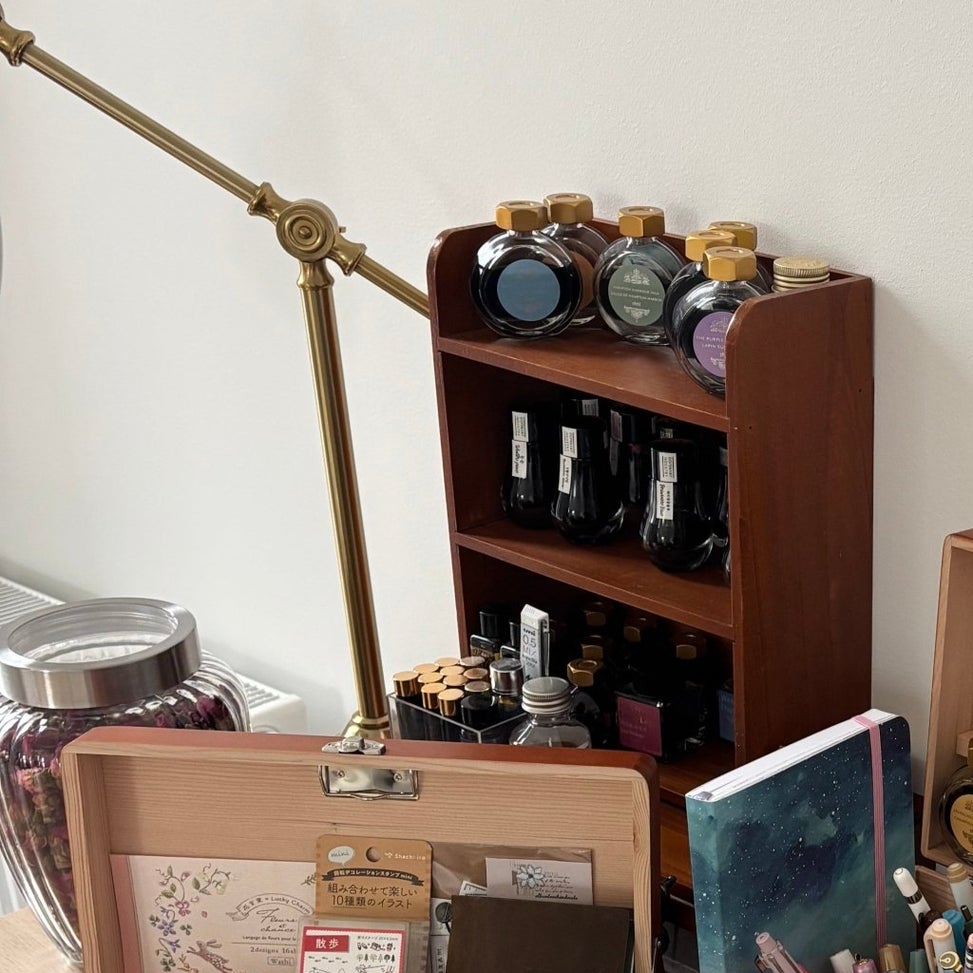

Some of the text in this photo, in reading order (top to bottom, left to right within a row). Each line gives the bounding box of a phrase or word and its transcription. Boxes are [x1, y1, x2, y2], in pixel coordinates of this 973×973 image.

[328, 882, 418, 897] 組み合わせて楽しい
[332, 894, 413, 909] 10種類のイラスト
[315, 938, 339, 949] 散歩
